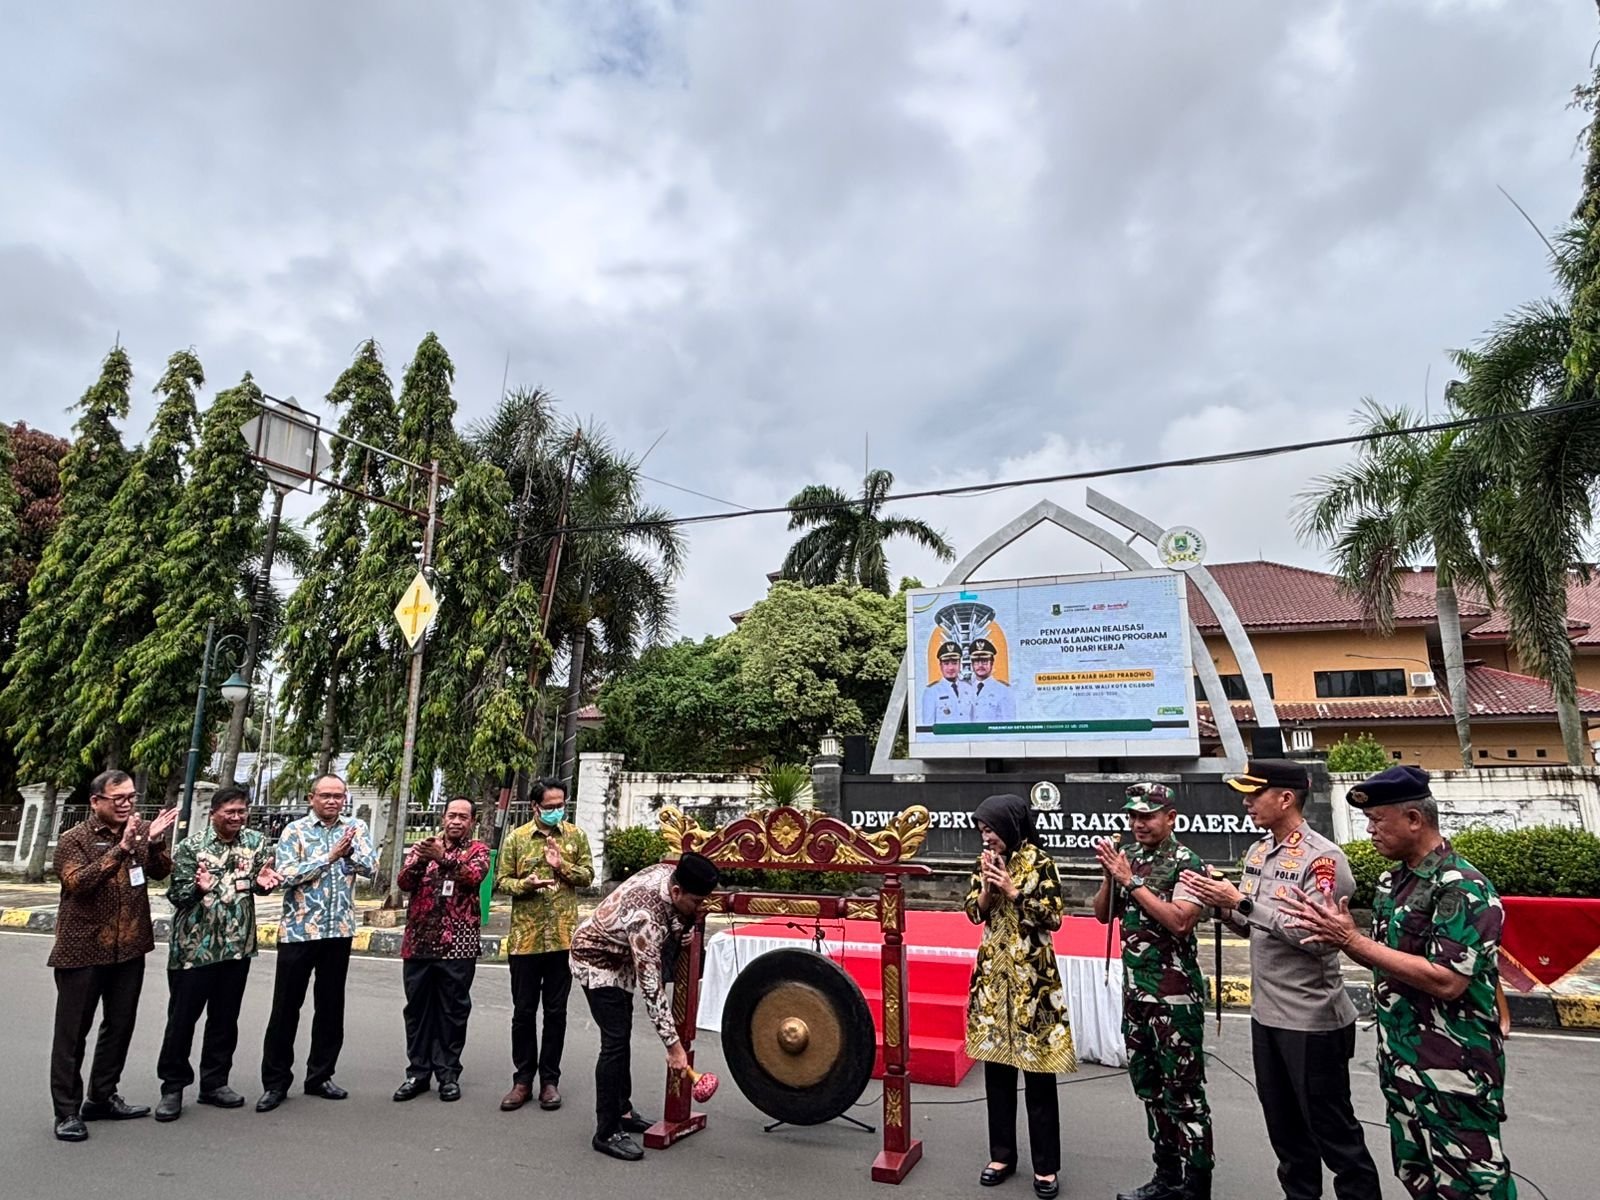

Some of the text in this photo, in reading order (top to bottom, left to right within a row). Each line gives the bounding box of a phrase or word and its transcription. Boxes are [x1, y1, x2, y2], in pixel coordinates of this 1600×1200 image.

[1040, 623, 1144, 636] PENYAMPAIAN REALISASI
[1020, 638, 1062, 646] PROGRAM
[1070, 634, 1121, 644] LAUNCHING
[1122, 632, 1168, 641] PROGRAM
[1060, 643, 1125, 653] 100 HARI KERJA
[1274, 870, 1300, 881] POLRI
